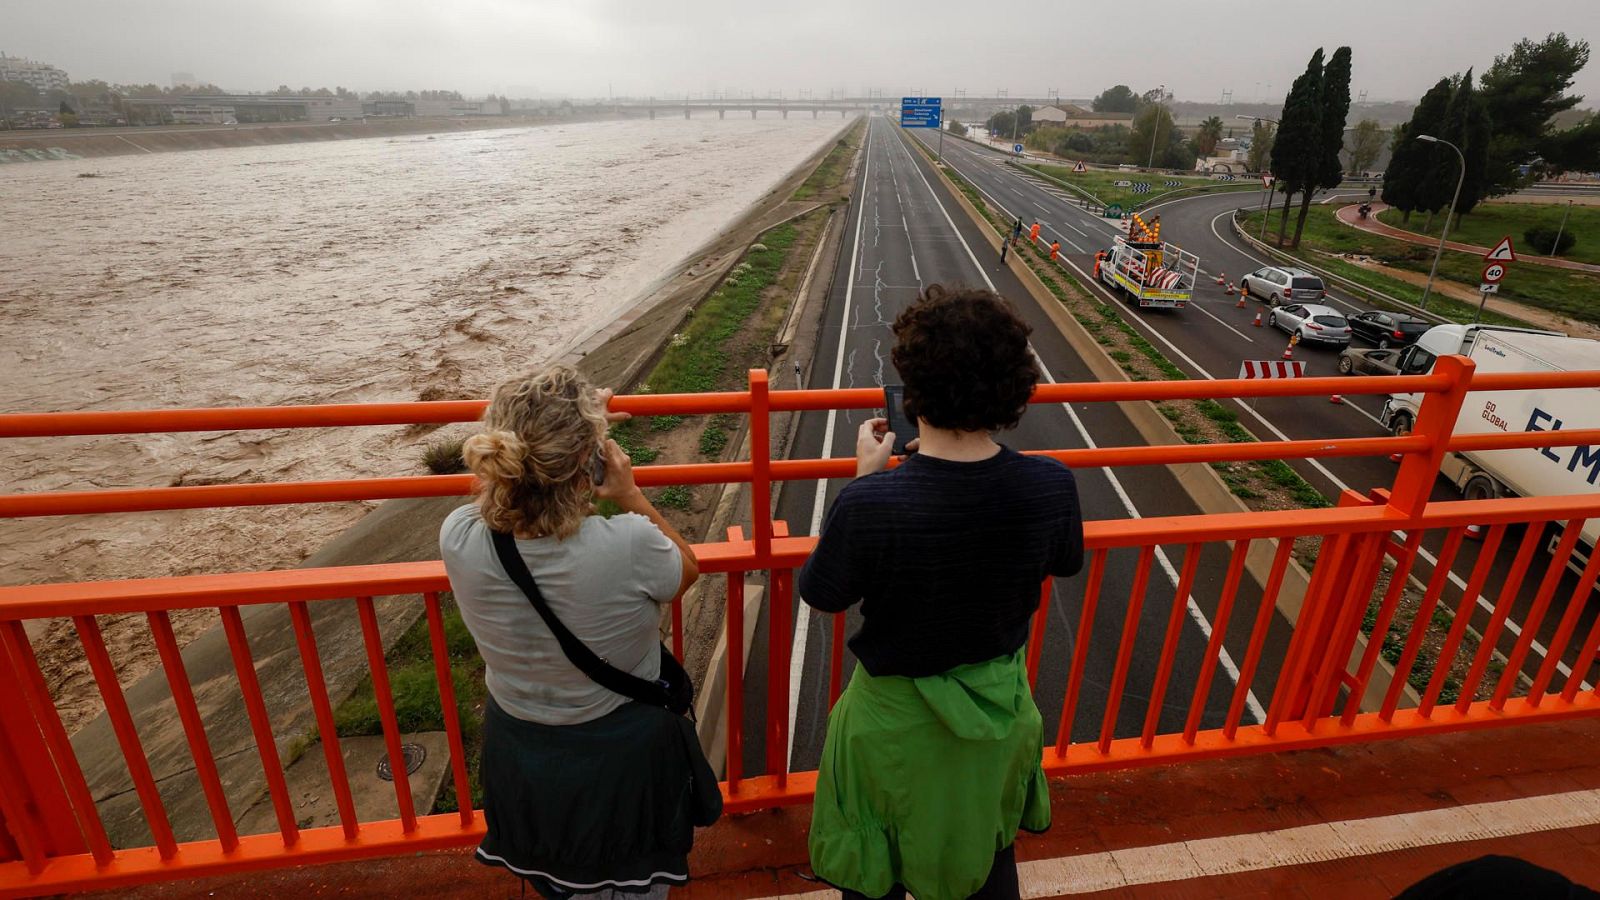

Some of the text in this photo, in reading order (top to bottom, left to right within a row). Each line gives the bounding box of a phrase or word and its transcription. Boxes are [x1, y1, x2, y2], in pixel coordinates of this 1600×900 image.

[1488, 269, 1501, 277] 40
[1485, 400, 1497, 413] GO
[1481, 409, 1508, 432] GLOBAL
